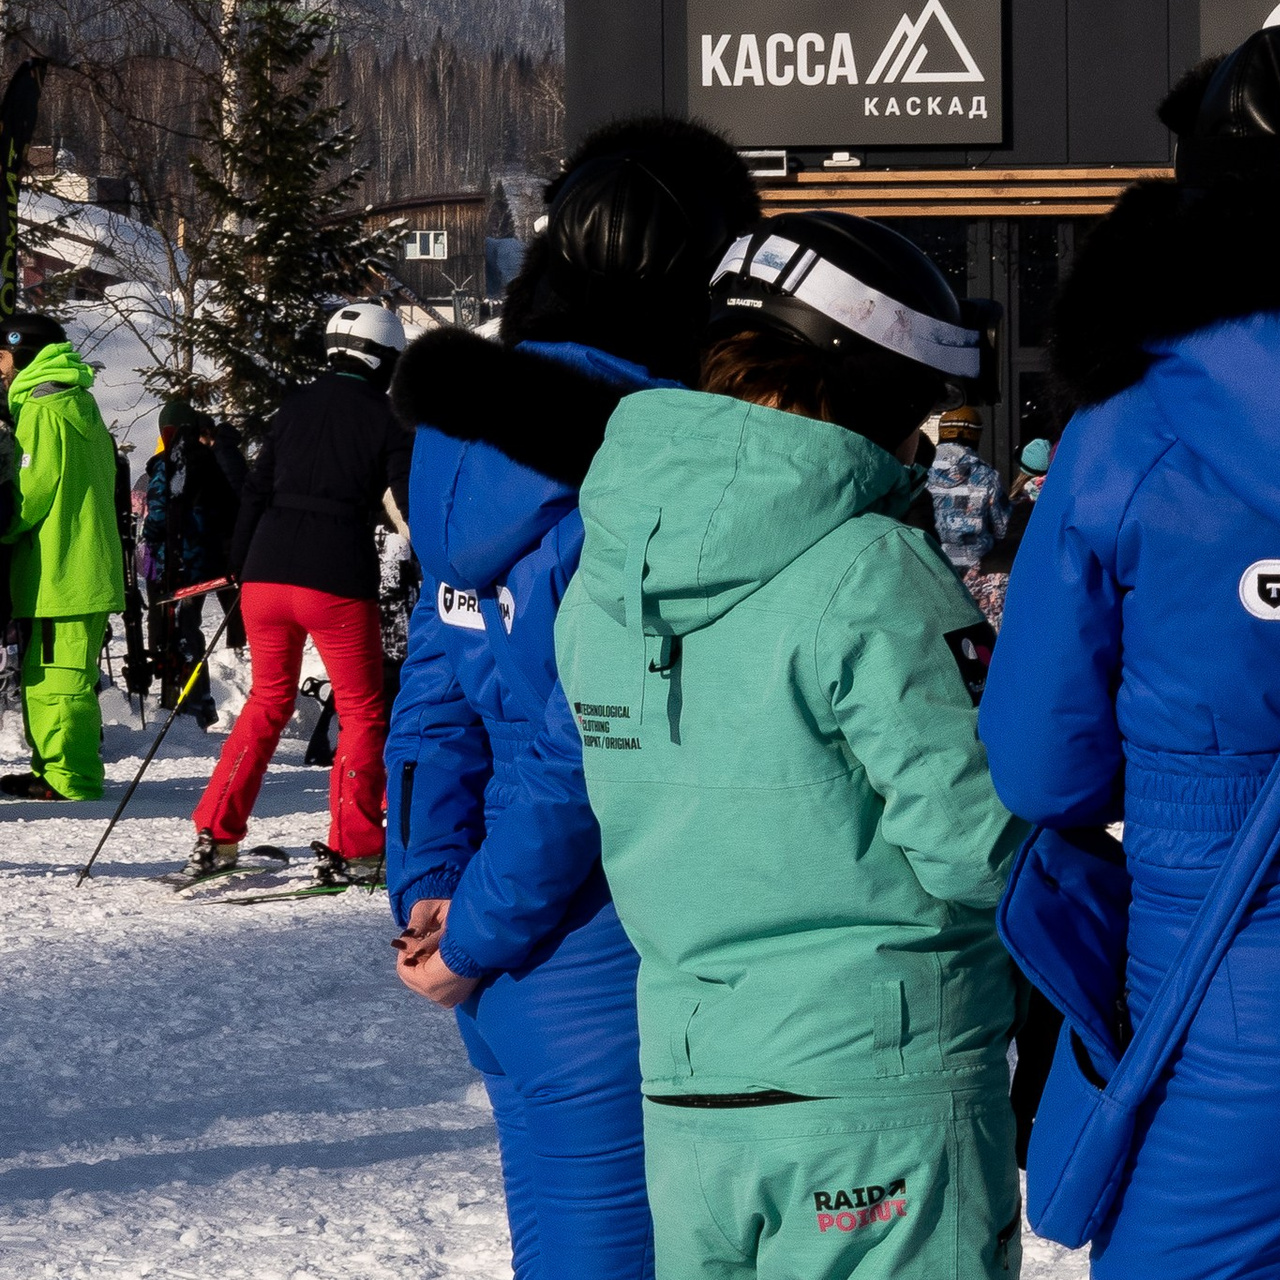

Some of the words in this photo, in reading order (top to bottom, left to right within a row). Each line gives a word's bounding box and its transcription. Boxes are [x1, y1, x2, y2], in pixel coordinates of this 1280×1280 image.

[701, 32, 858, 87] КАССА
[864, 95, 988, 119] КАСКАД
[581, 703, 631, 719] TECHNOLOGICAL
[582, 719, 610, 734] CLOTHING
[813, 1184, 886, 1212] RAID
[816, 1198, 908, 1233] POINT
